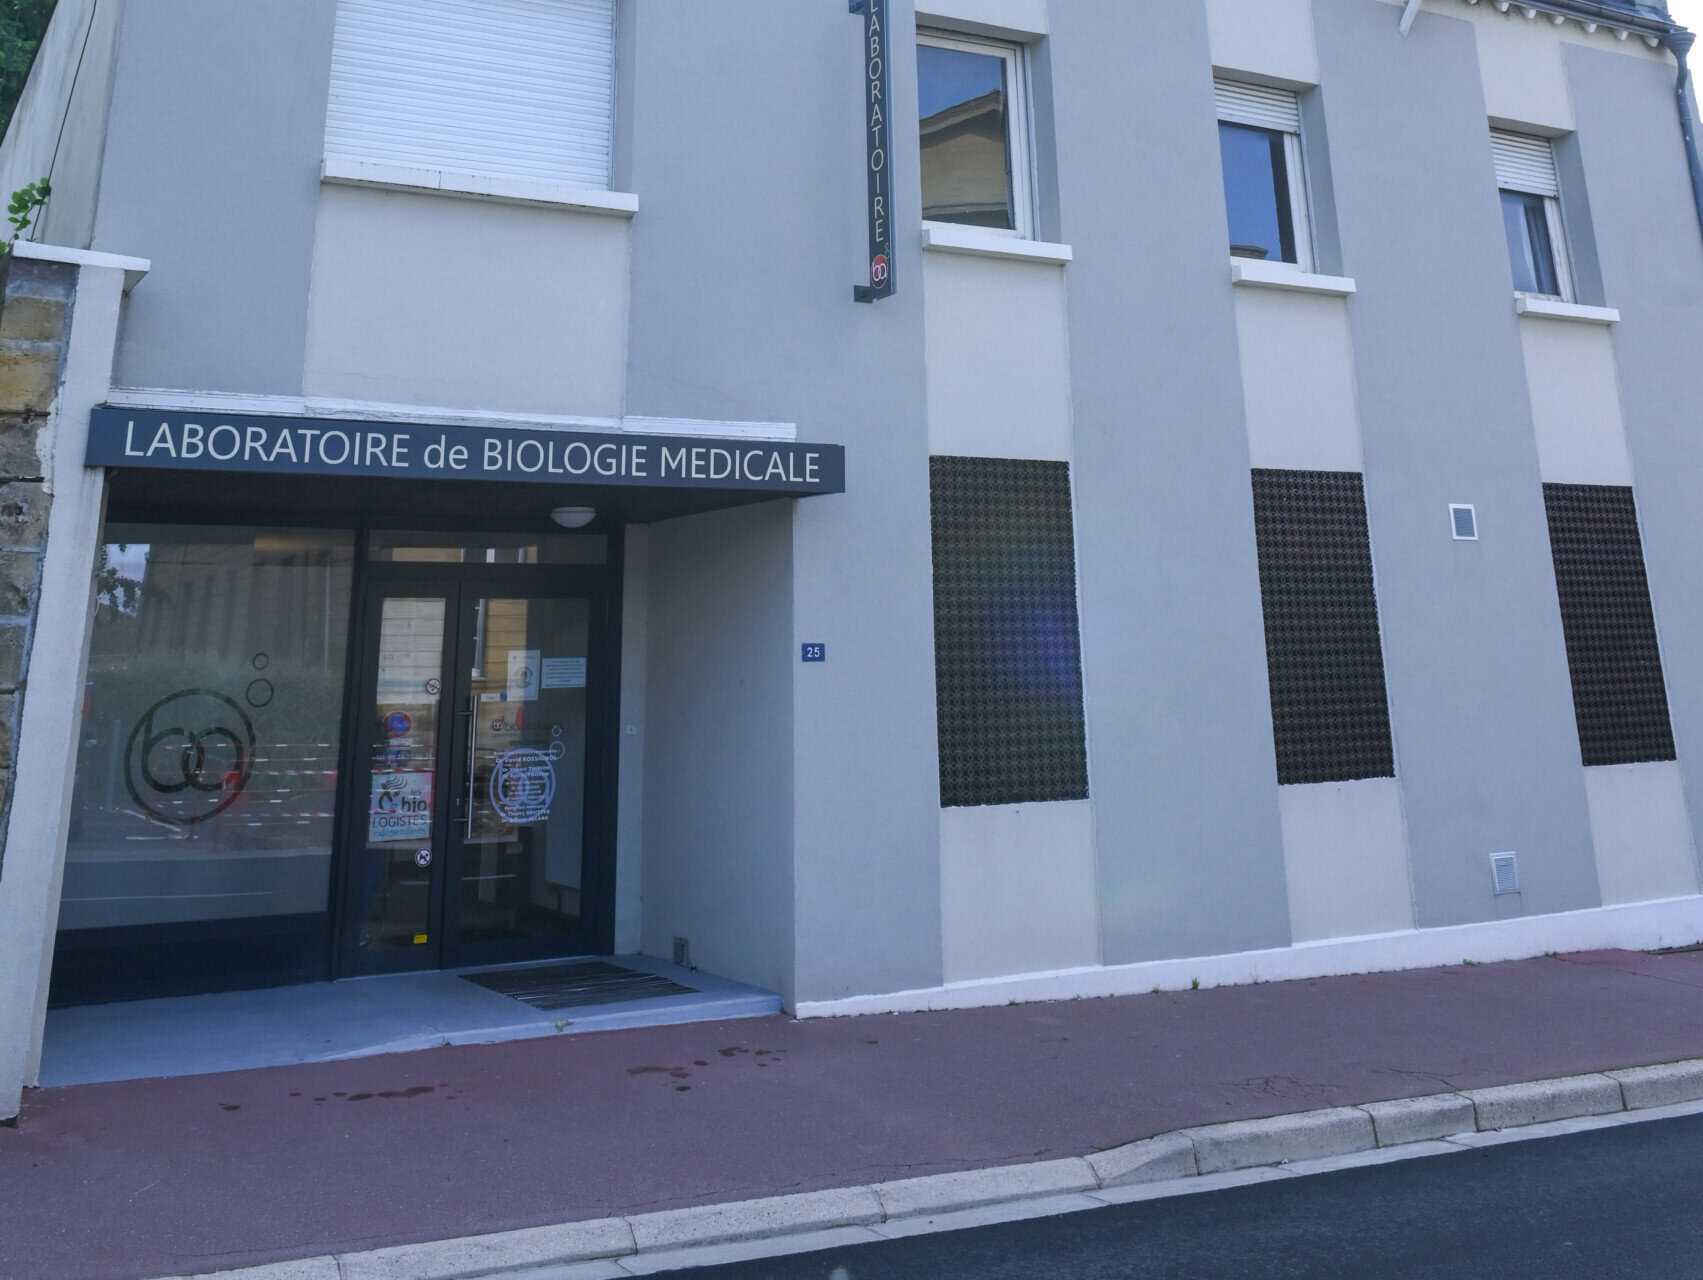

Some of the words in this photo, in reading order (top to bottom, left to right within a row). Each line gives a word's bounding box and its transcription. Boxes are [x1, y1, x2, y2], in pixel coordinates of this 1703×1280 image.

[124, 420, 410, 468] LABORATOIRE
[423, 434, 469, 470] de
[483, 438, 647, 477] BIOLOGIE
[660, 446, 820, 483] MEDICALE
[806, 646, 820, 658] 25
[410, 788, 422, 796] les
[372, 814, 427, 829] LOGISTES
